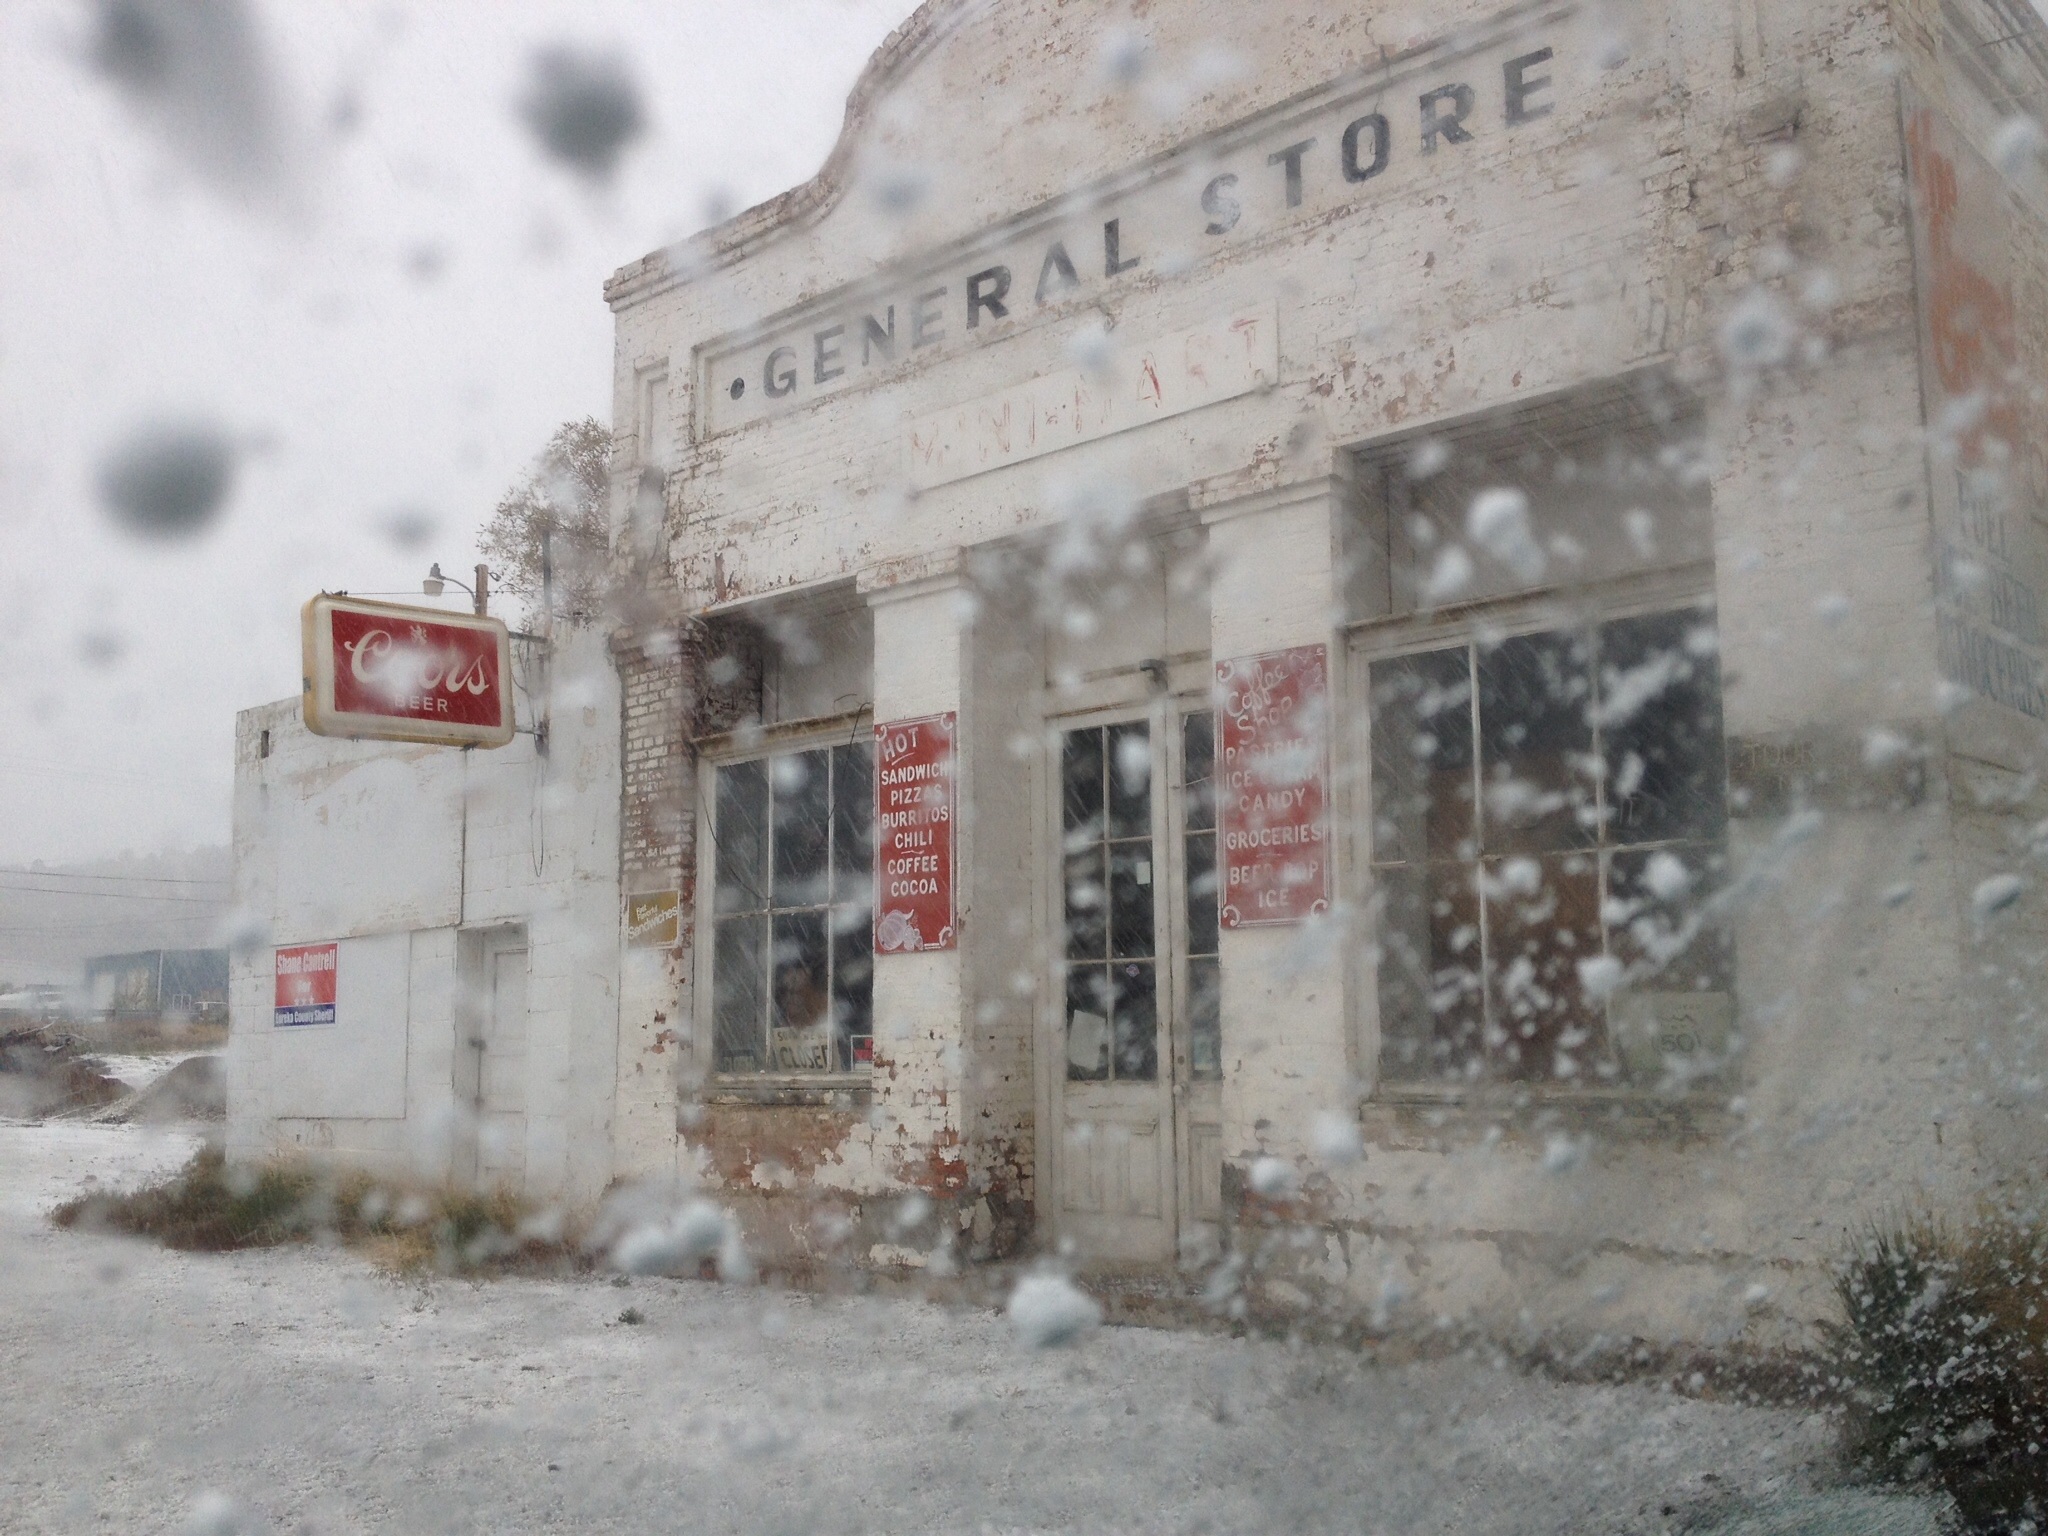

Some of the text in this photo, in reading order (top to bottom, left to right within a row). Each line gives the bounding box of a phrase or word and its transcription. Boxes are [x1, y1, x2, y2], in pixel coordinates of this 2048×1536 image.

[763, 46, 1556, 399] GENERAL STORE
[344, 628, 489, 695] Cors
[1227, 660, 1292, 718] Coffee
[395, 693, 449, 713] BEER
[883, 727, 920, 762] HOT
[881, 761, 951, 786] SANDWICH
[1226, 769, 1254, 791] ICE
[1240, 787, 1306, 812] CANDY
[881, 804, 950, 830] BURRITOS
[895, 829, 933, 849] CHILI
[1226, 824, 1321, 851] GROCERIES
[887, 854, 939, 876] COFFEE
[1230, 863, 1274, 886] BEER
[891, 877, 939, 898] COCOA
[1258, 888, 1290, 909] ICE
